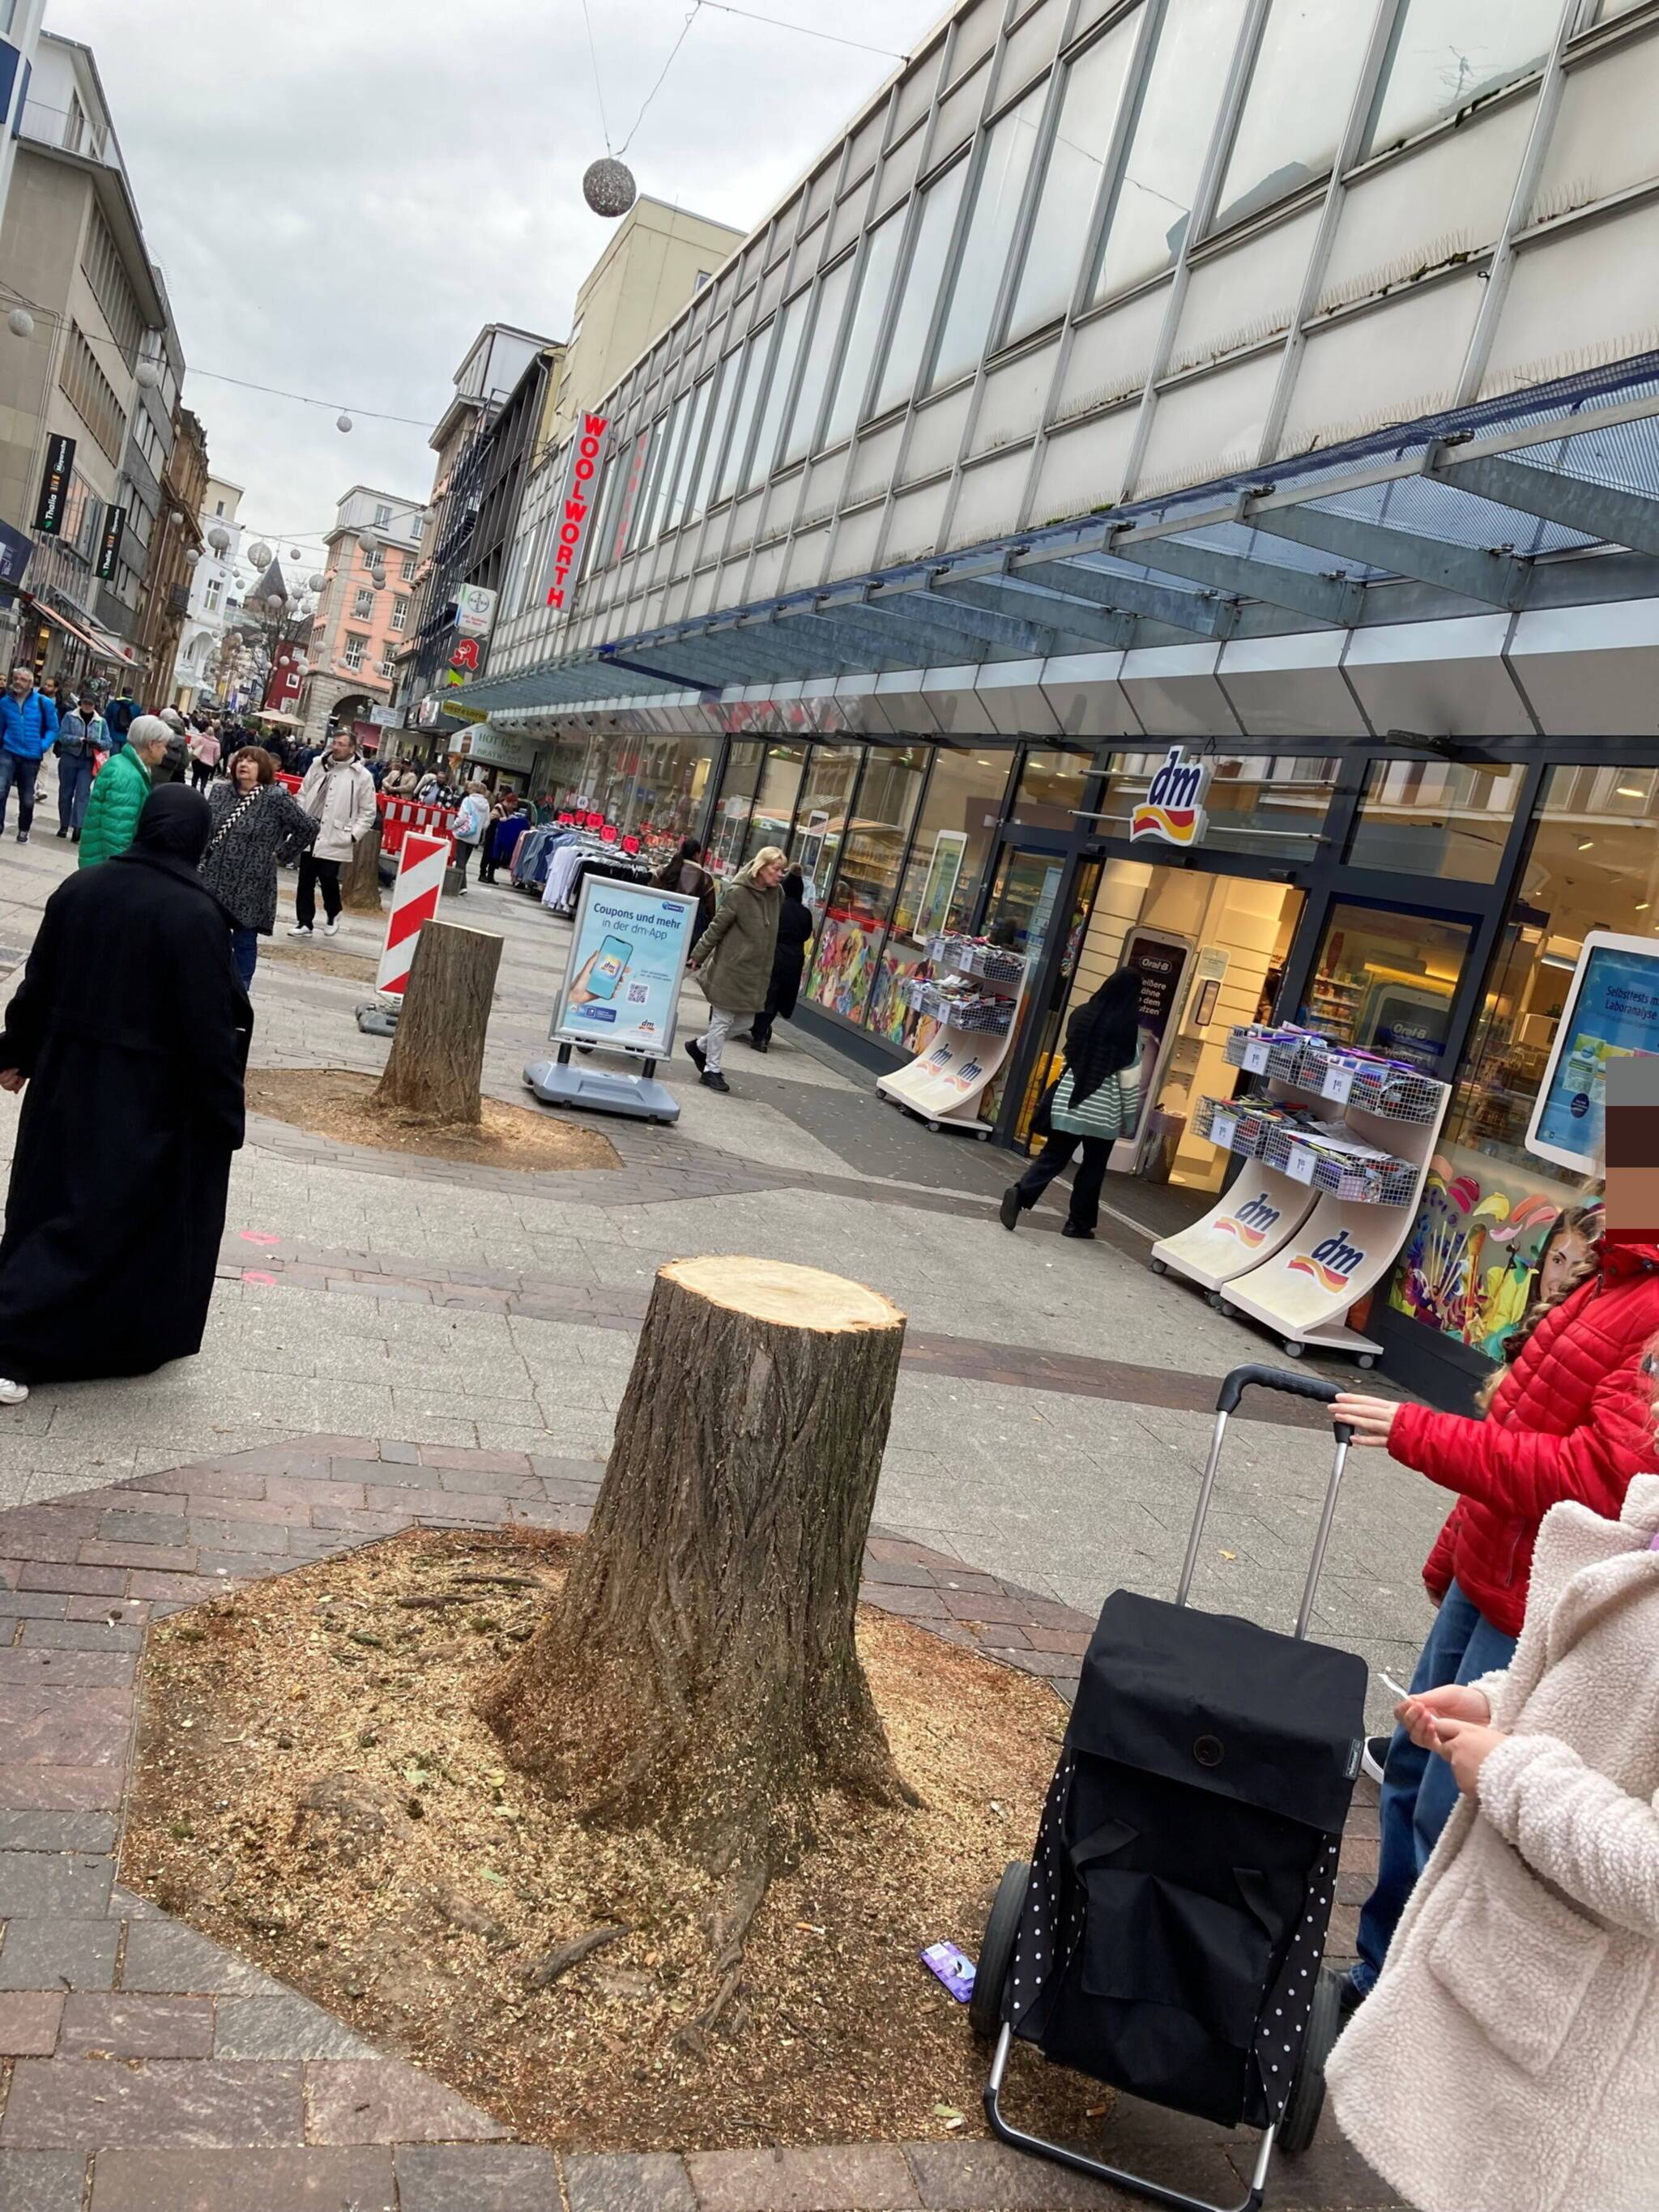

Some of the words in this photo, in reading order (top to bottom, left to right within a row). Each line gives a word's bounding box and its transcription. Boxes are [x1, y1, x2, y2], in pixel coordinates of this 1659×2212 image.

[45, 494, 58, 519] Thalia
[546, 414, 608, 608] WOOLWORTH
[479, 733, 497, 745] HOT
[1149, 751, 1201, 808] dm
[594, 903, 633, 919] Coupons
[636, 914, 655, 923] und
[656, 918, 681, 929] mehr
[602, 918, 611, 927] in
[613, 920, 629, 931] der
[631, 924, 667, 940] dm-App
[603, 961, 616, 970] dm
[1141, 978, 1166, 990] eißere
[1606, 985, 1649, 1004] Selbsttests
[1606, 999, 1657, 1020] Laboranalyse
[929, 1043, 953, 1066] dm
[957, 1057, 983, 1081] dm
[1235, 1193, 1280, 1231] dm
[1311, 1230, 1364, 1274] dm
